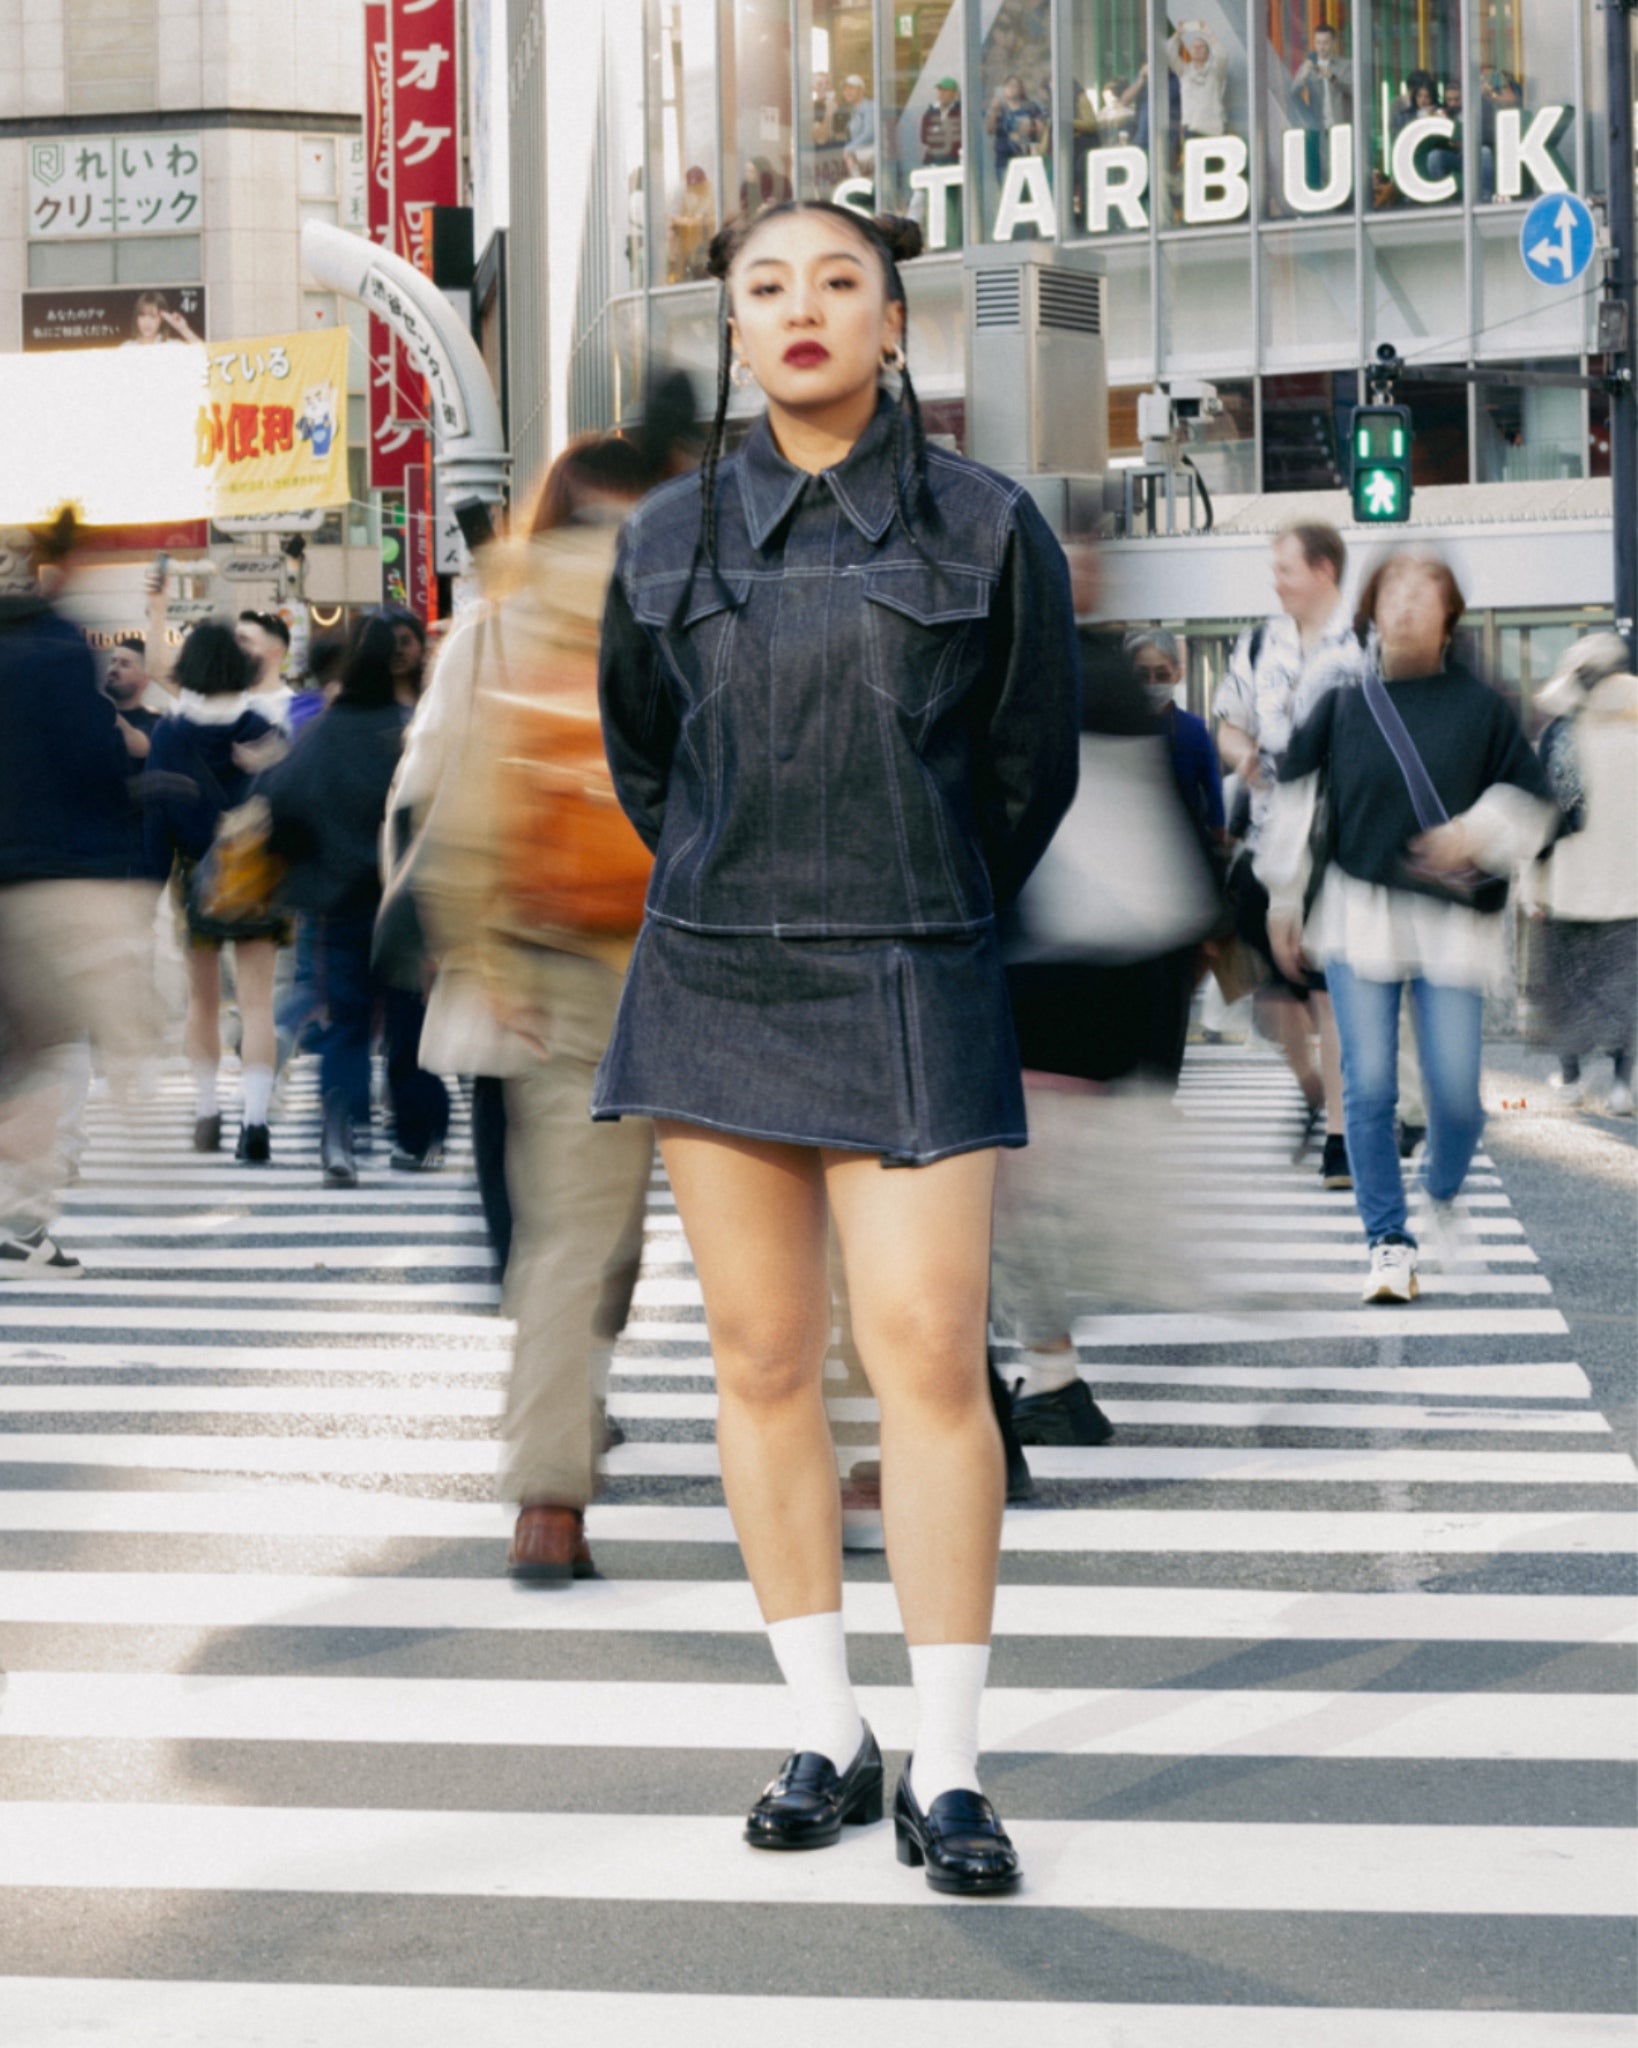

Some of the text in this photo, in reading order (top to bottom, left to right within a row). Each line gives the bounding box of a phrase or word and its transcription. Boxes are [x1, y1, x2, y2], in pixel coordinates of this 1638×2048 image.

[397, 0, 452, 167] オケ
[75, 143, 198, 182] れいわ
[35, 190, 198, 229] クリニック
